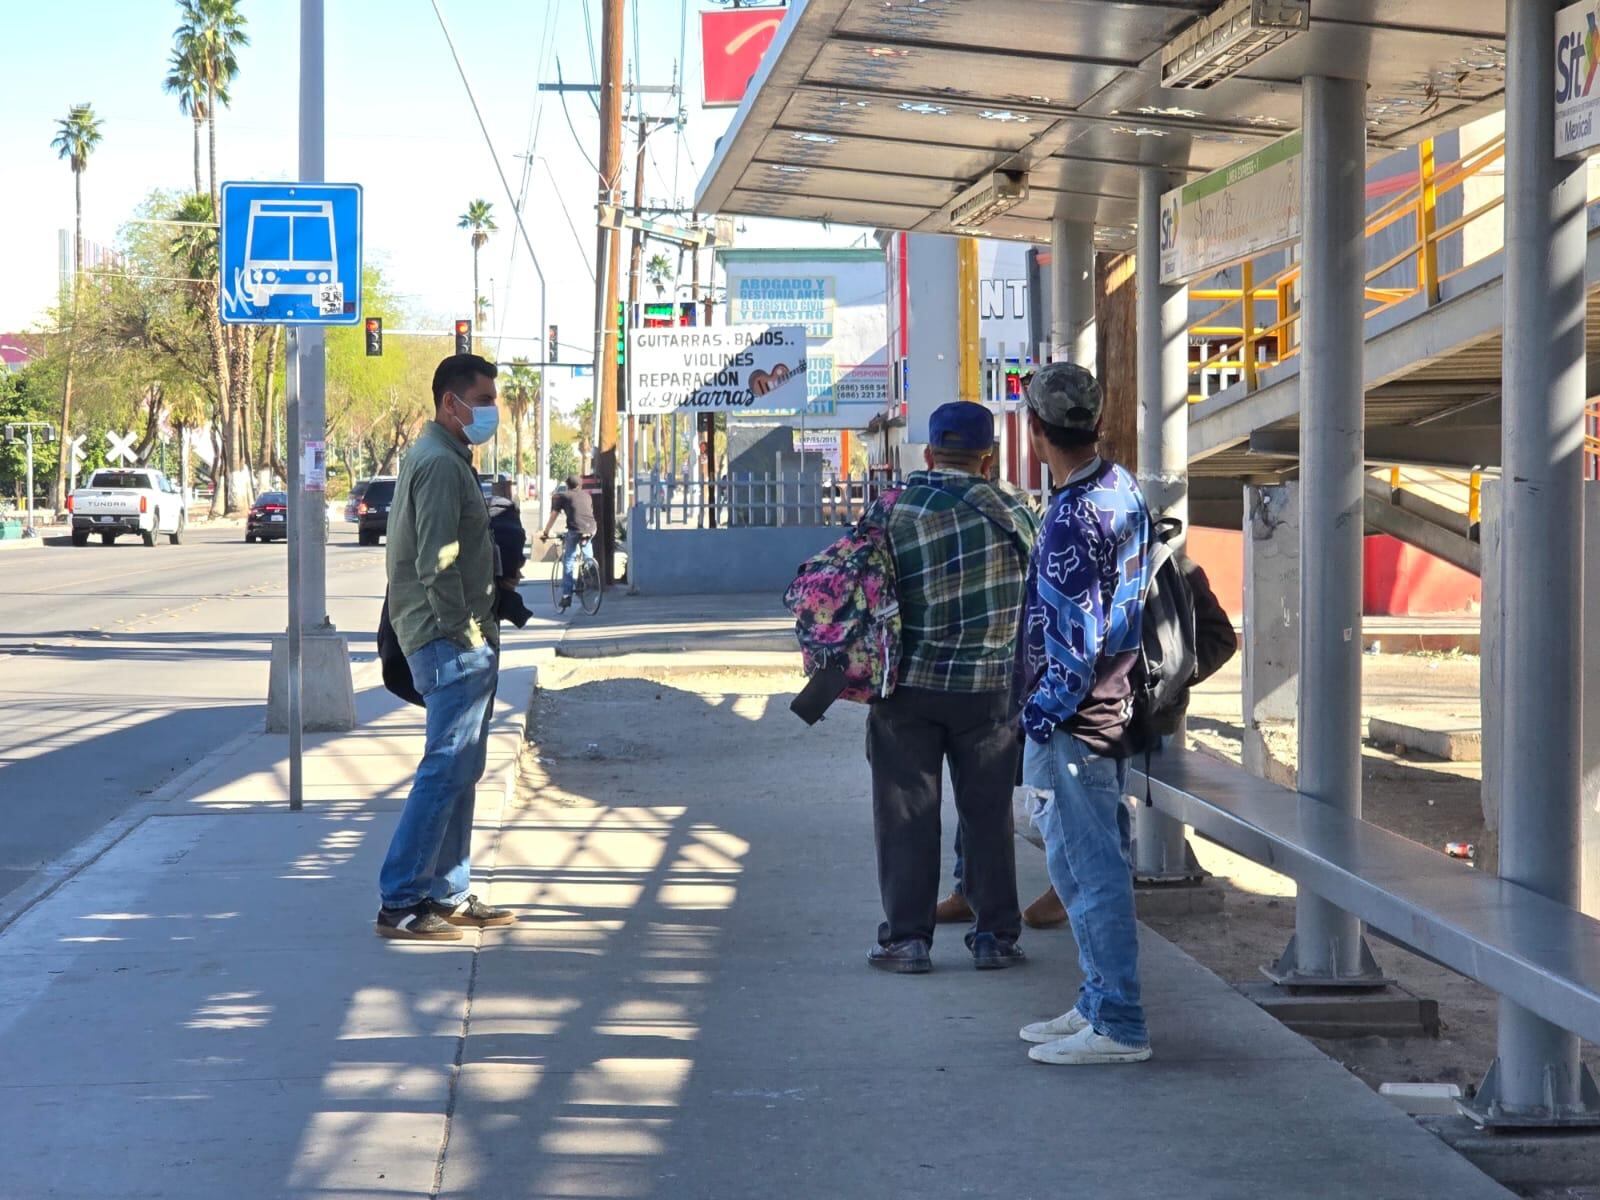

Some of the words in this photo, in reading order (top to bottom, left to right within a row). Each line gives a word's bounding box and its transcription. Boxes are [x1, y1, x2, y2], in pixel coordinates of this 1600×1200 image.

[740, 279, 812, 289] ABOGADO
[815, 279, 825, 289] Y
[797, 289, 825, 299] ANTE
[741, 300, 750, 310] EL
[752, 300, 799, 310] REGISTRO
[800, 300, 824, 310] CIVIL
[740, 311, 748, 320] Y
[752, 311, 824, 320] CATASTRO
[683, 352, 754, 368] VIOLINES
[638, 366, 739, 388] REPARACIÓN
[638, 391, 656, 408] de
[659, 387, 756, 409] guitarras
